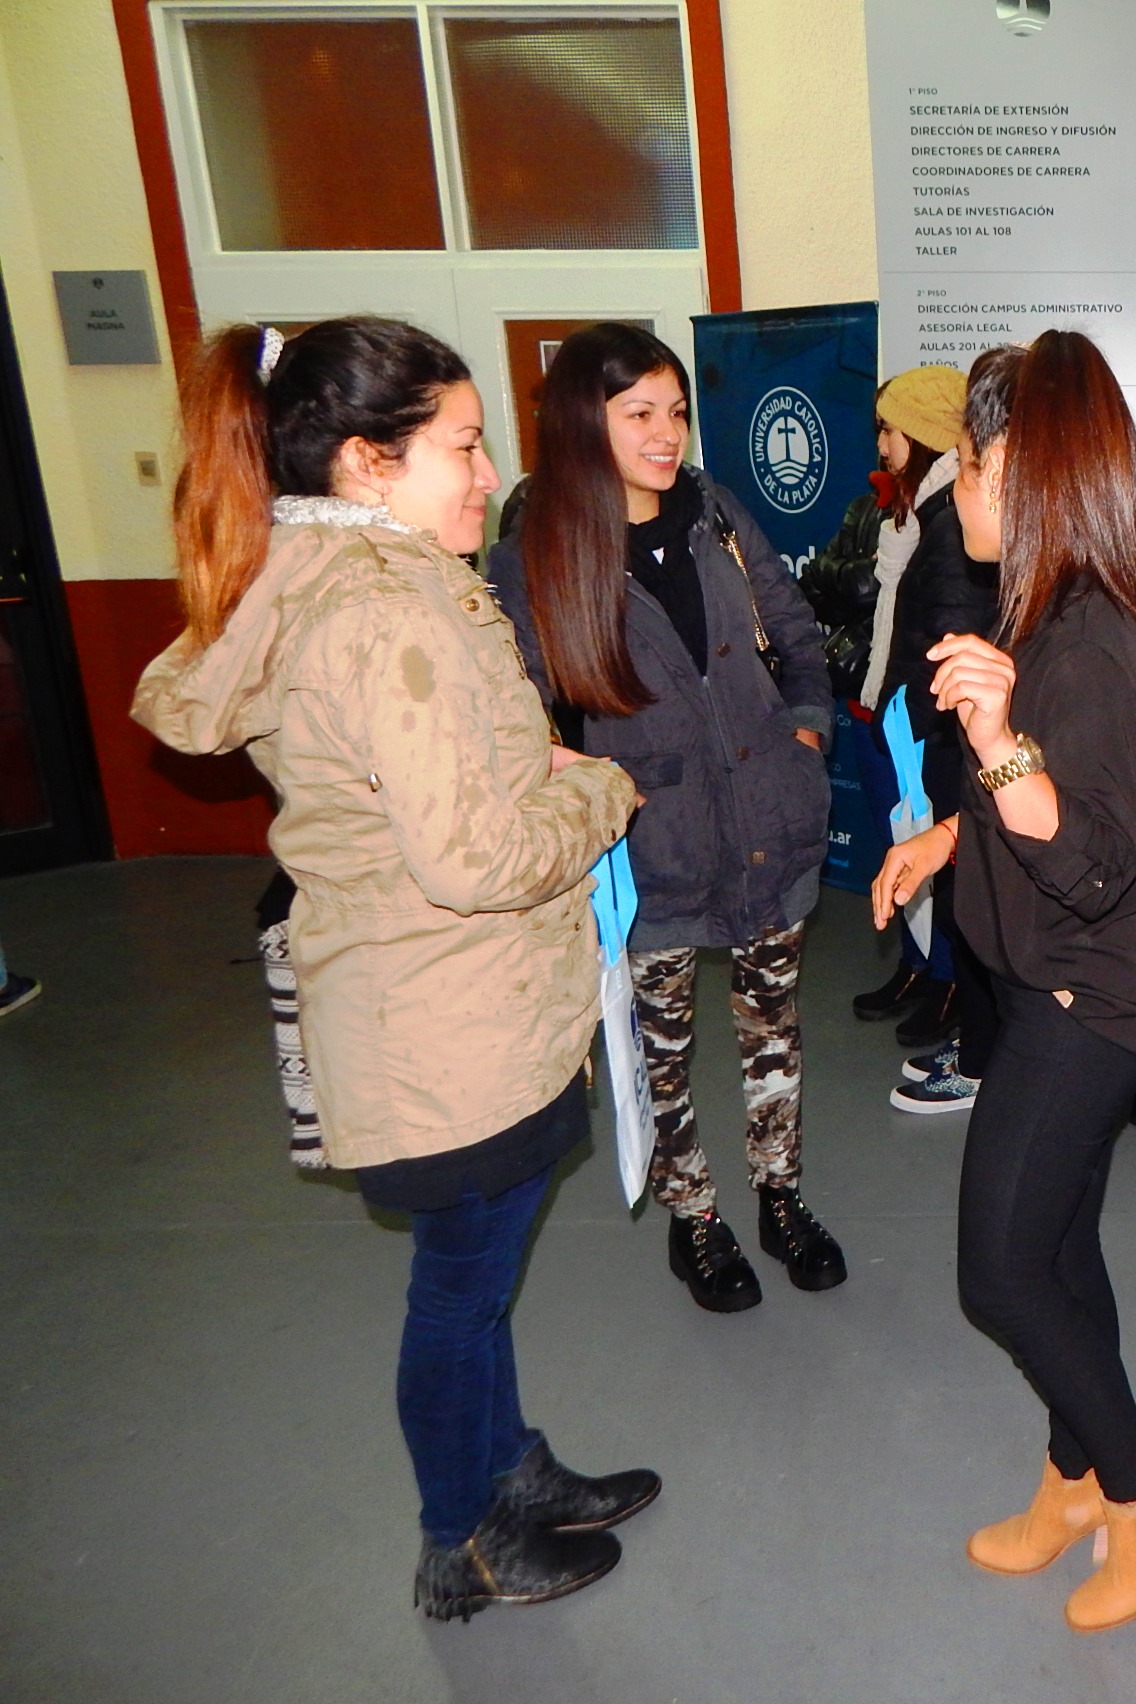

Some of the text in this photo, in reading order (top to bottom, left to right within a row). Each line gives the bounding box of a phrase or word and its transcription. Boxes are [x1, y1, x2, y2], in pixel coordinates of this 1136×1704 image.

[917, 87, 938, 96] PISO
[909, 103, 1069, 116] SECRETARÍA DE EXTENSIÓN
[910, 123, 1117, 136] DIRECCIÓN DE INGRESO Y DIFUSIÓN
[911, 146, 1061, 156] DIRECTORES DE CARRERA
[912, 166, 1091, 177] COORDINADORES DE CARRERA
[912, 184, 970, 197] TUTORÍAS
[913, 204, 1054, 217] SALA DE INVESTIGACIÓN
[914, 226, 1012, 237] AULAS 101 AL 108
[915, 246, 958, 256] TALLER
[927, 289, 947, 297] PISO
[917, 303, 1123, 314] DIRECCIÓN CAMPUS ADMINISTRATIVO
[918, 321, 1012, 333] ASESORÍA LEGAL
[919, 341, 956, 351] AULAS
[958, 341, 976, 351] 201
[755, 396, 793, 462] UNIVERSIDAD
[764, 474, 818, 505] DE LA PLATA
